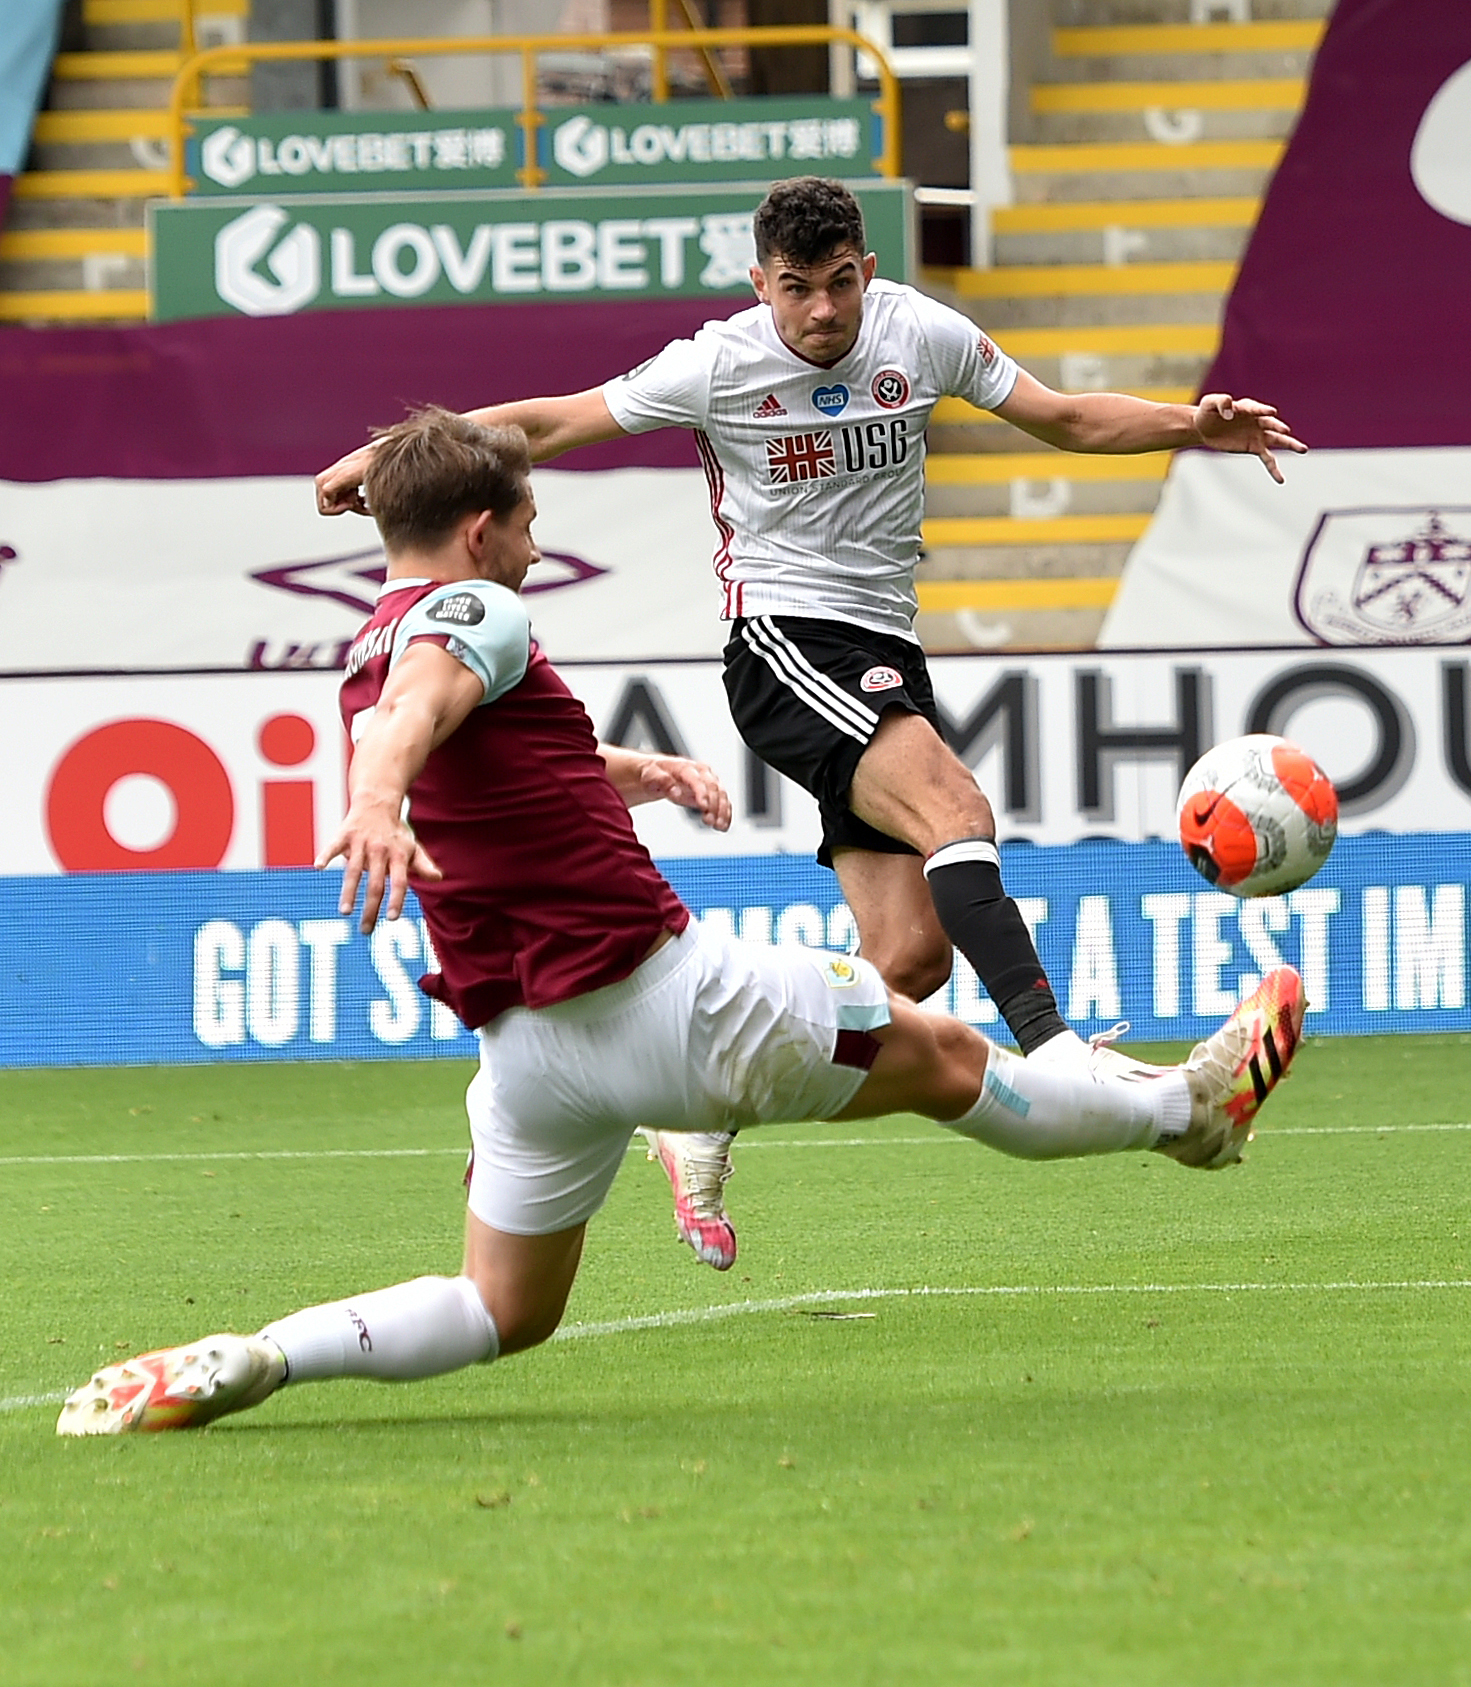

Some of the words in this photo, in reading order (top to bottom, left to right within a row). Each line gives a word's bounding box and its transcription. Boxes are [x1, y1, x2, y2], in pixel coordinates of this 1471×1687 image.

[257, 131, 431, 174] LOVEBET
[611, 121, 787, 165] LOVEBET
[331, 217, 697, 297] LOVEBET
[753, 408, 788, 419] adidas
[818, 394, 843, 406] NHS
[841, 419, 907, 473] USG
[769, 487, 808, 497] UNION
[811, 475, 870, 493] STANDARD
[43, 711, 317, 874] Oi
[1066, 896, 1122, 1020] A
[1142, 888, 1341, 1018] TEST
[193, 917, 351, 1048] GOT
